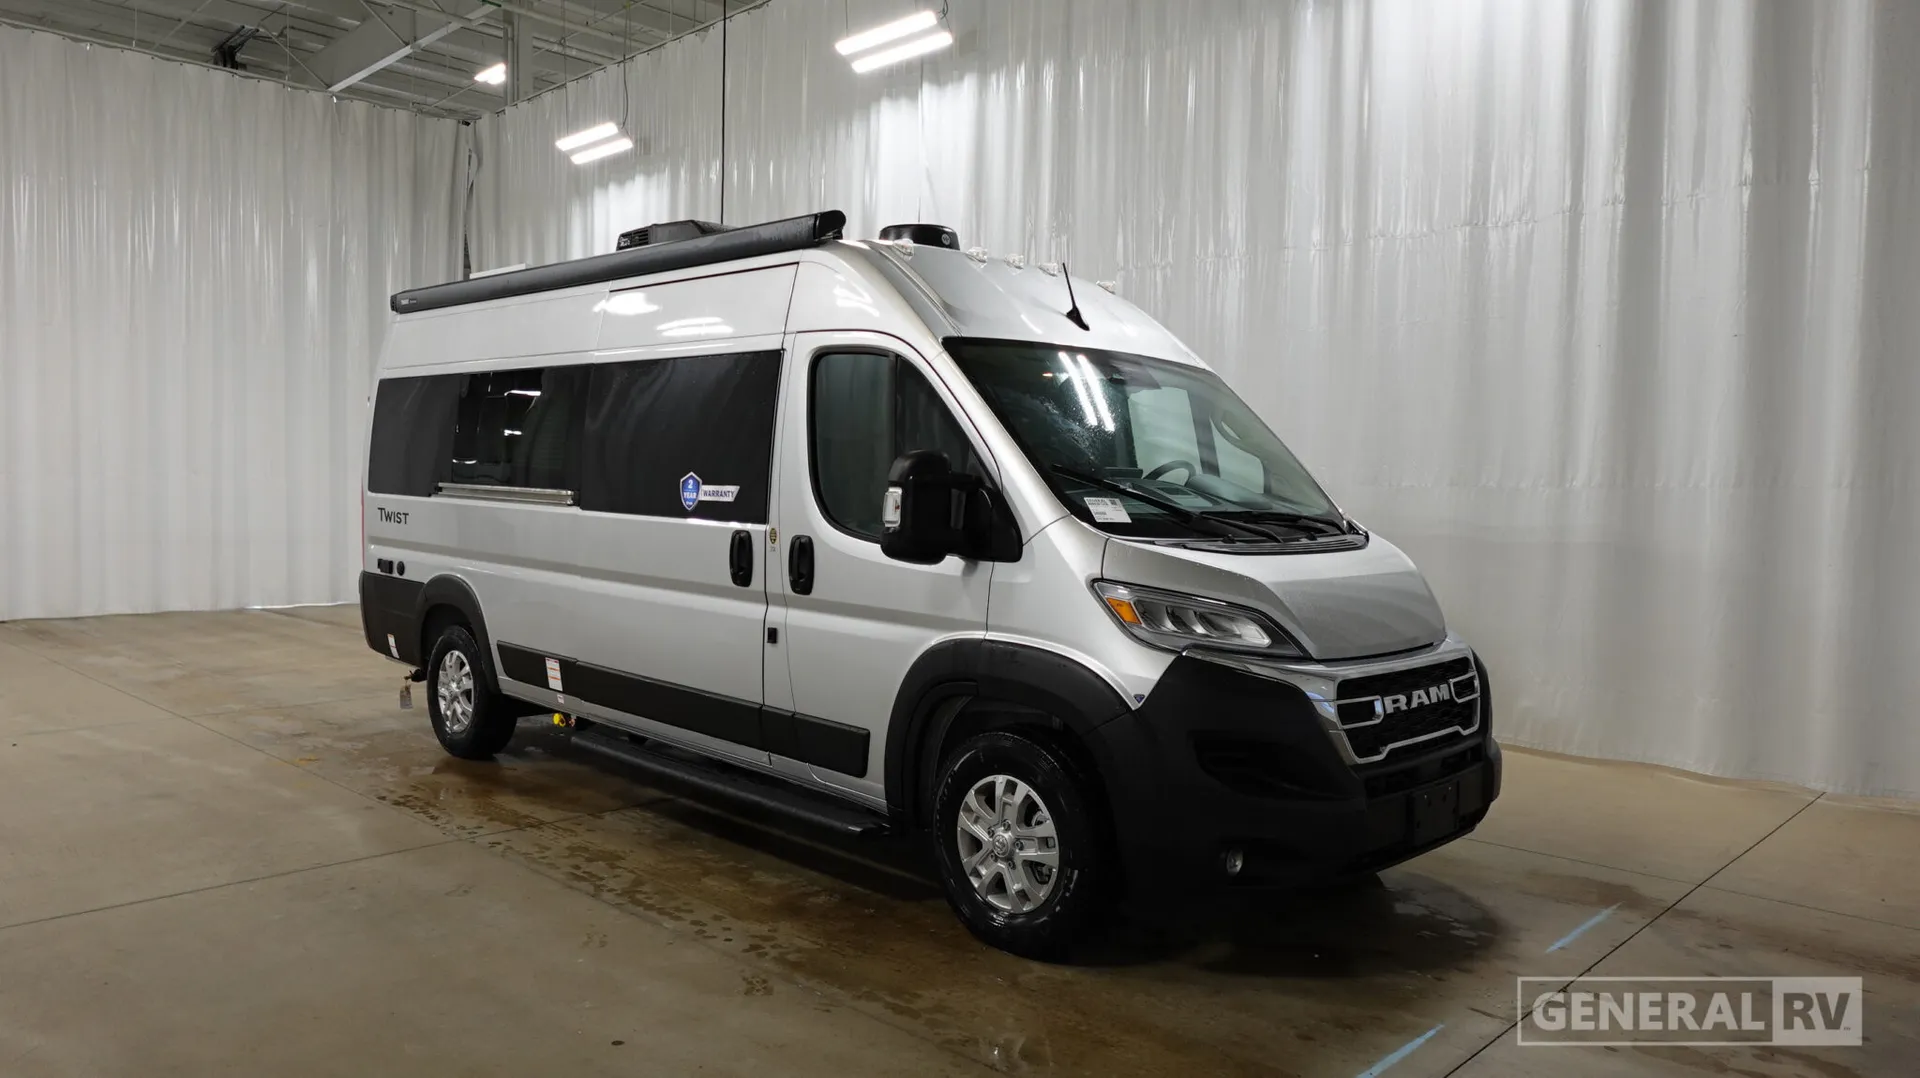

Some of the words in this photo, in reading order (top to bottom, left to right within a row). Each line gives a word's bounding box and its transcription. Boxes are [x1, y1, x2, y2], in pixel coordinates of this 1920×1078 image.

[687, 479, 694, 489] 2
[683, 492, 697, 500] YEAR
[703, 490, 735, 498] WARRANTY
[1383, 683, 1450, 714] RAM
